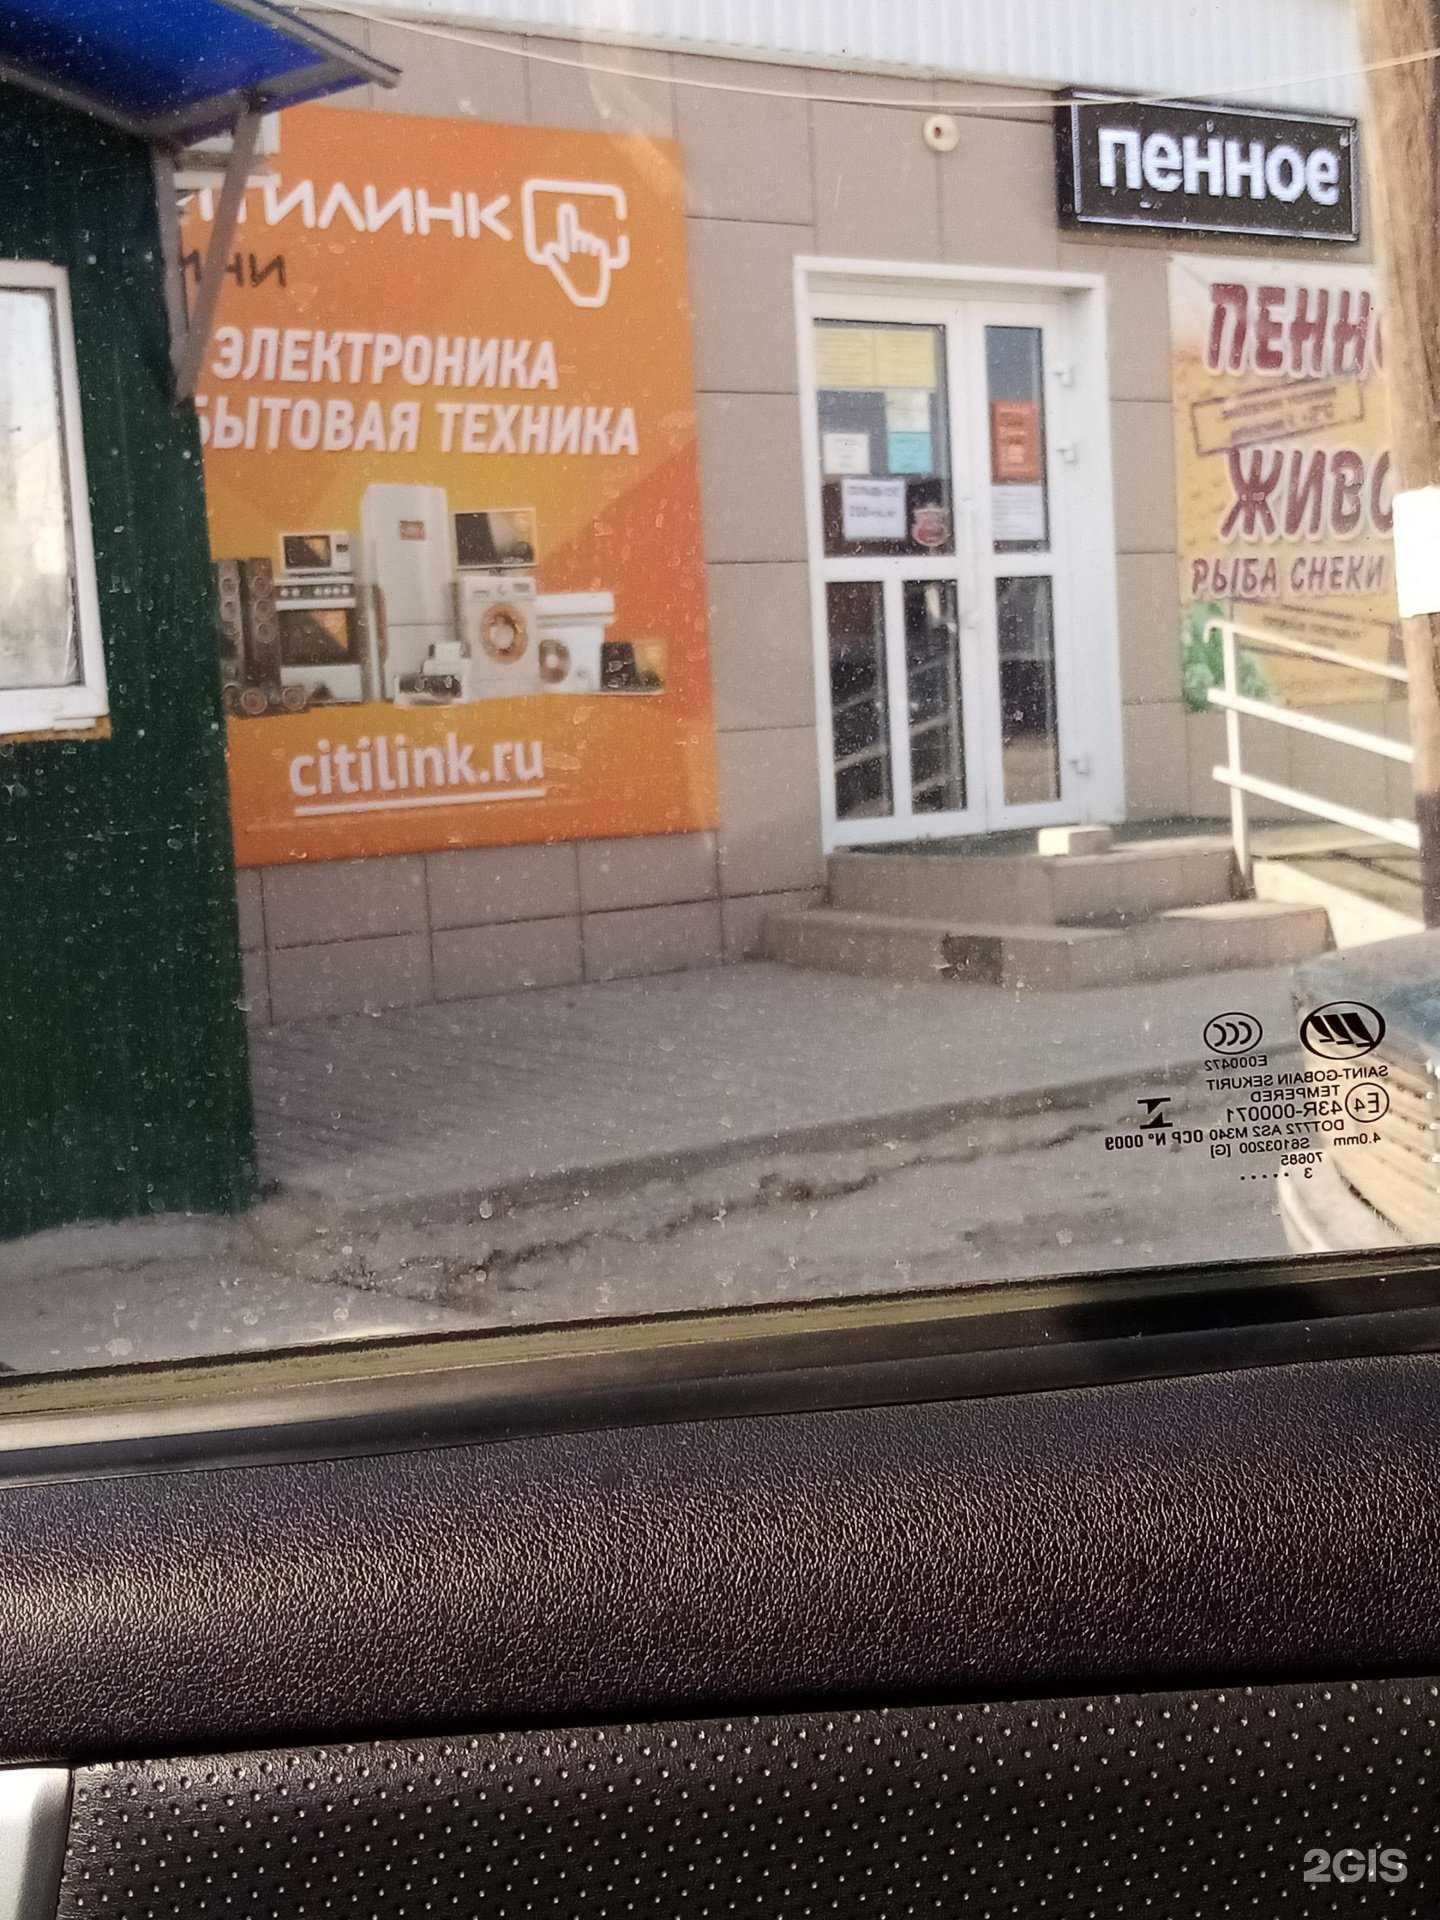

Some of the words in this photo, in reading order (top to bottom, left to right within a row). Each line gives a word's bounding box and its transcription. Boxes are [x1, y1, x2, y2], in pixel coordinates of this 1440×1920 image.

[212, 325, 559, 389] ЭЛЕКТРОНИКА
[1207, 282, 1384, 376] ПЕНН
[434, 401, 640, 455] ТЕХНИКА
[1191, 557, 1278, 594] РЫБА
[1290, 555, 1385, 591] СНЕКИ
[289, 731, 545, 797] citilink.ru
